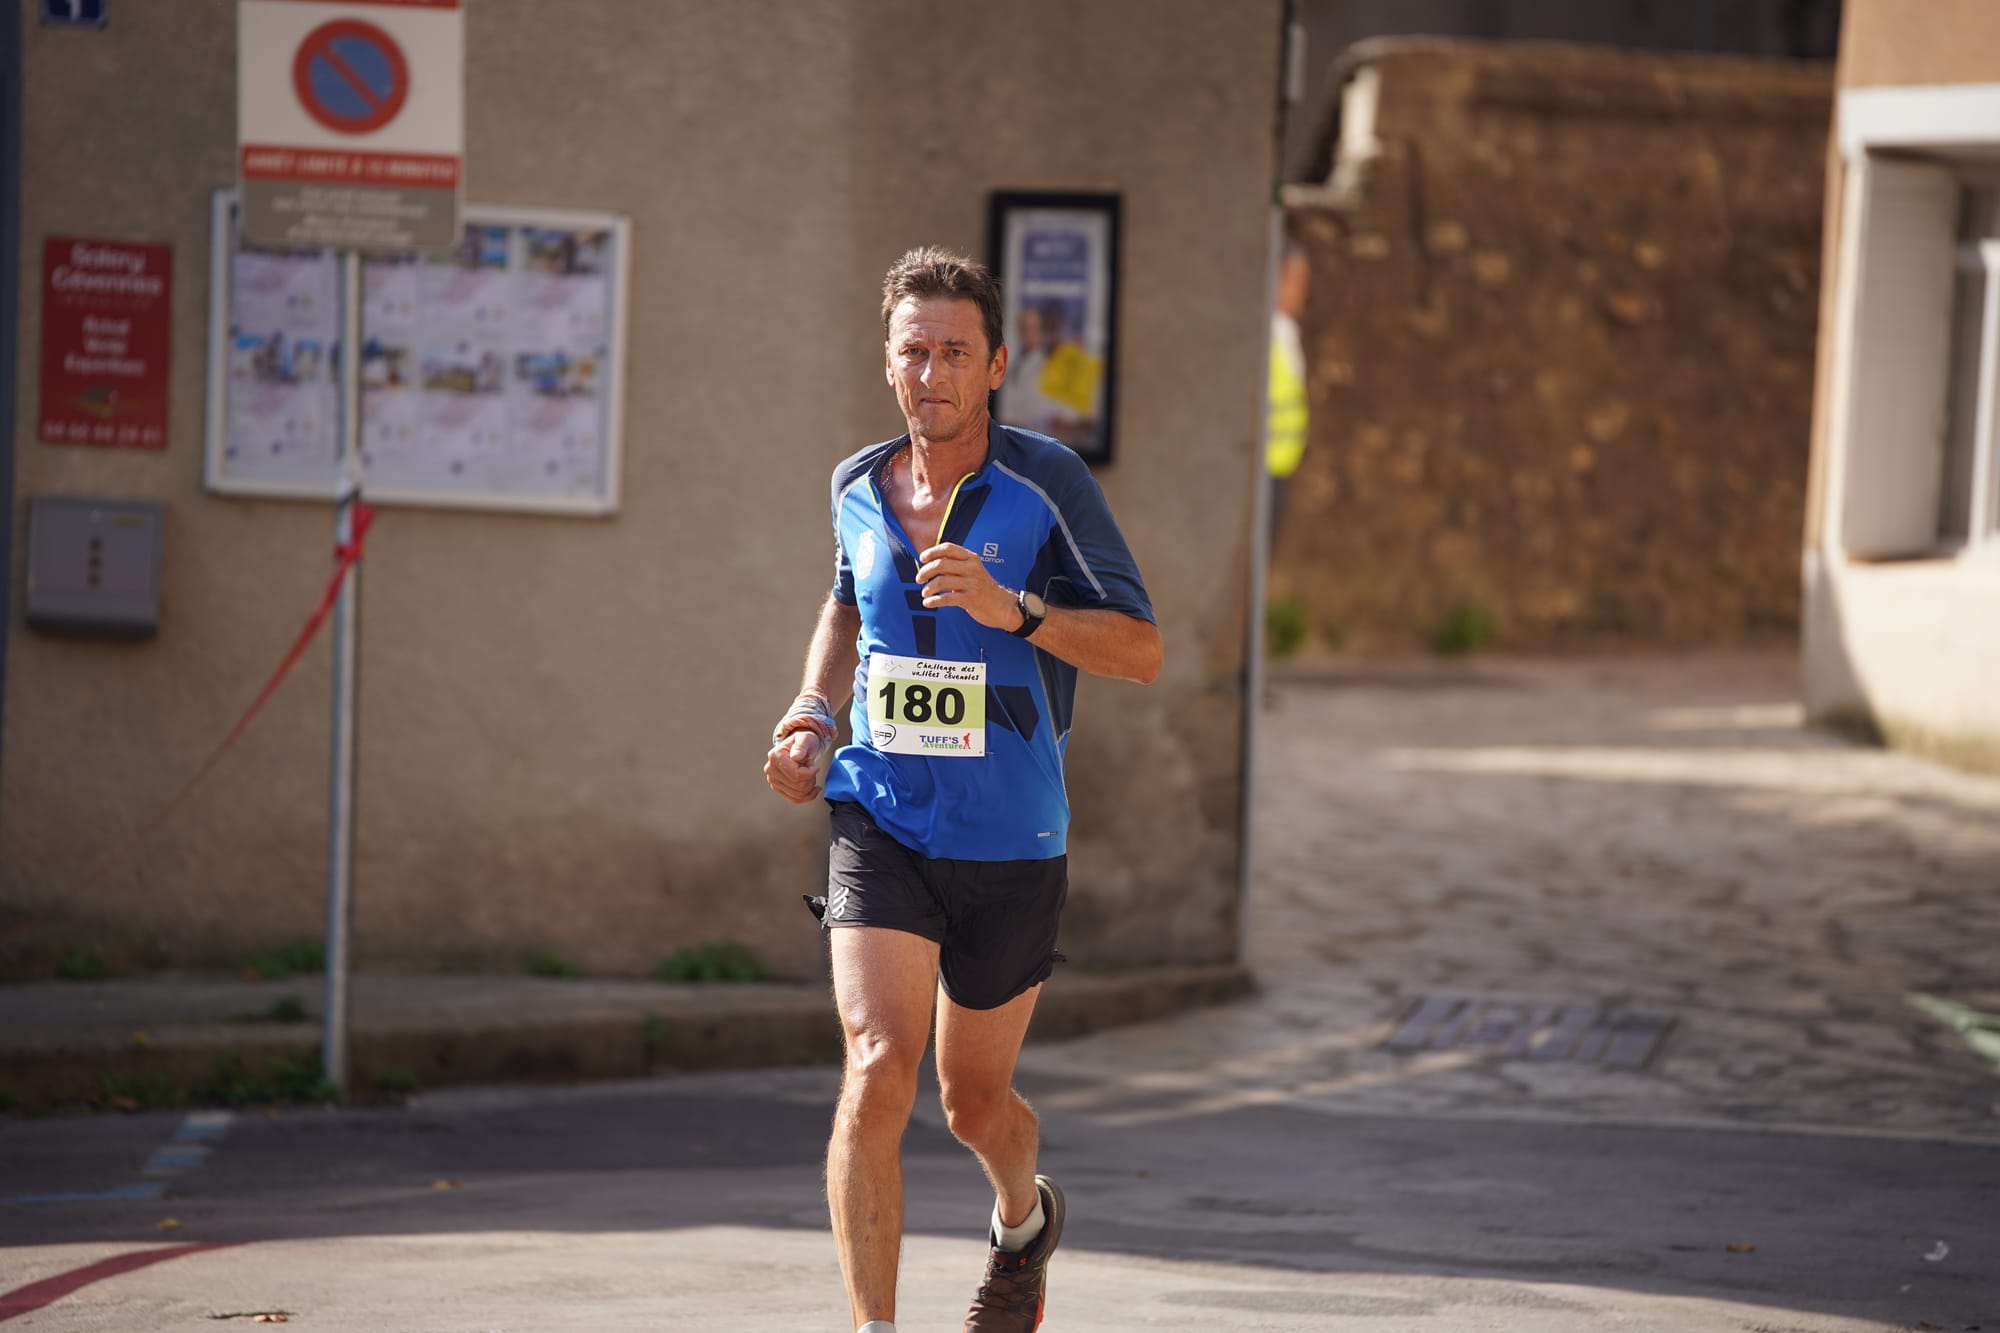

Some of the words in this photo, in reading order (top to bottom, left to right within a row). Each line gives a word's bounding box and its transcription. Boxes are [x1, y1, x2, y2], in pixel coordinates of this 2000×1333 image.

[985, 544, 997, 556] S
[916, 661, 957, 674] Challenge
[961, 665, 976, 673] des
[879, 681, 966, 725] 180
[919, 735, 959, 744] TUFF'S
[923, 742, 963, 750] Aventure
